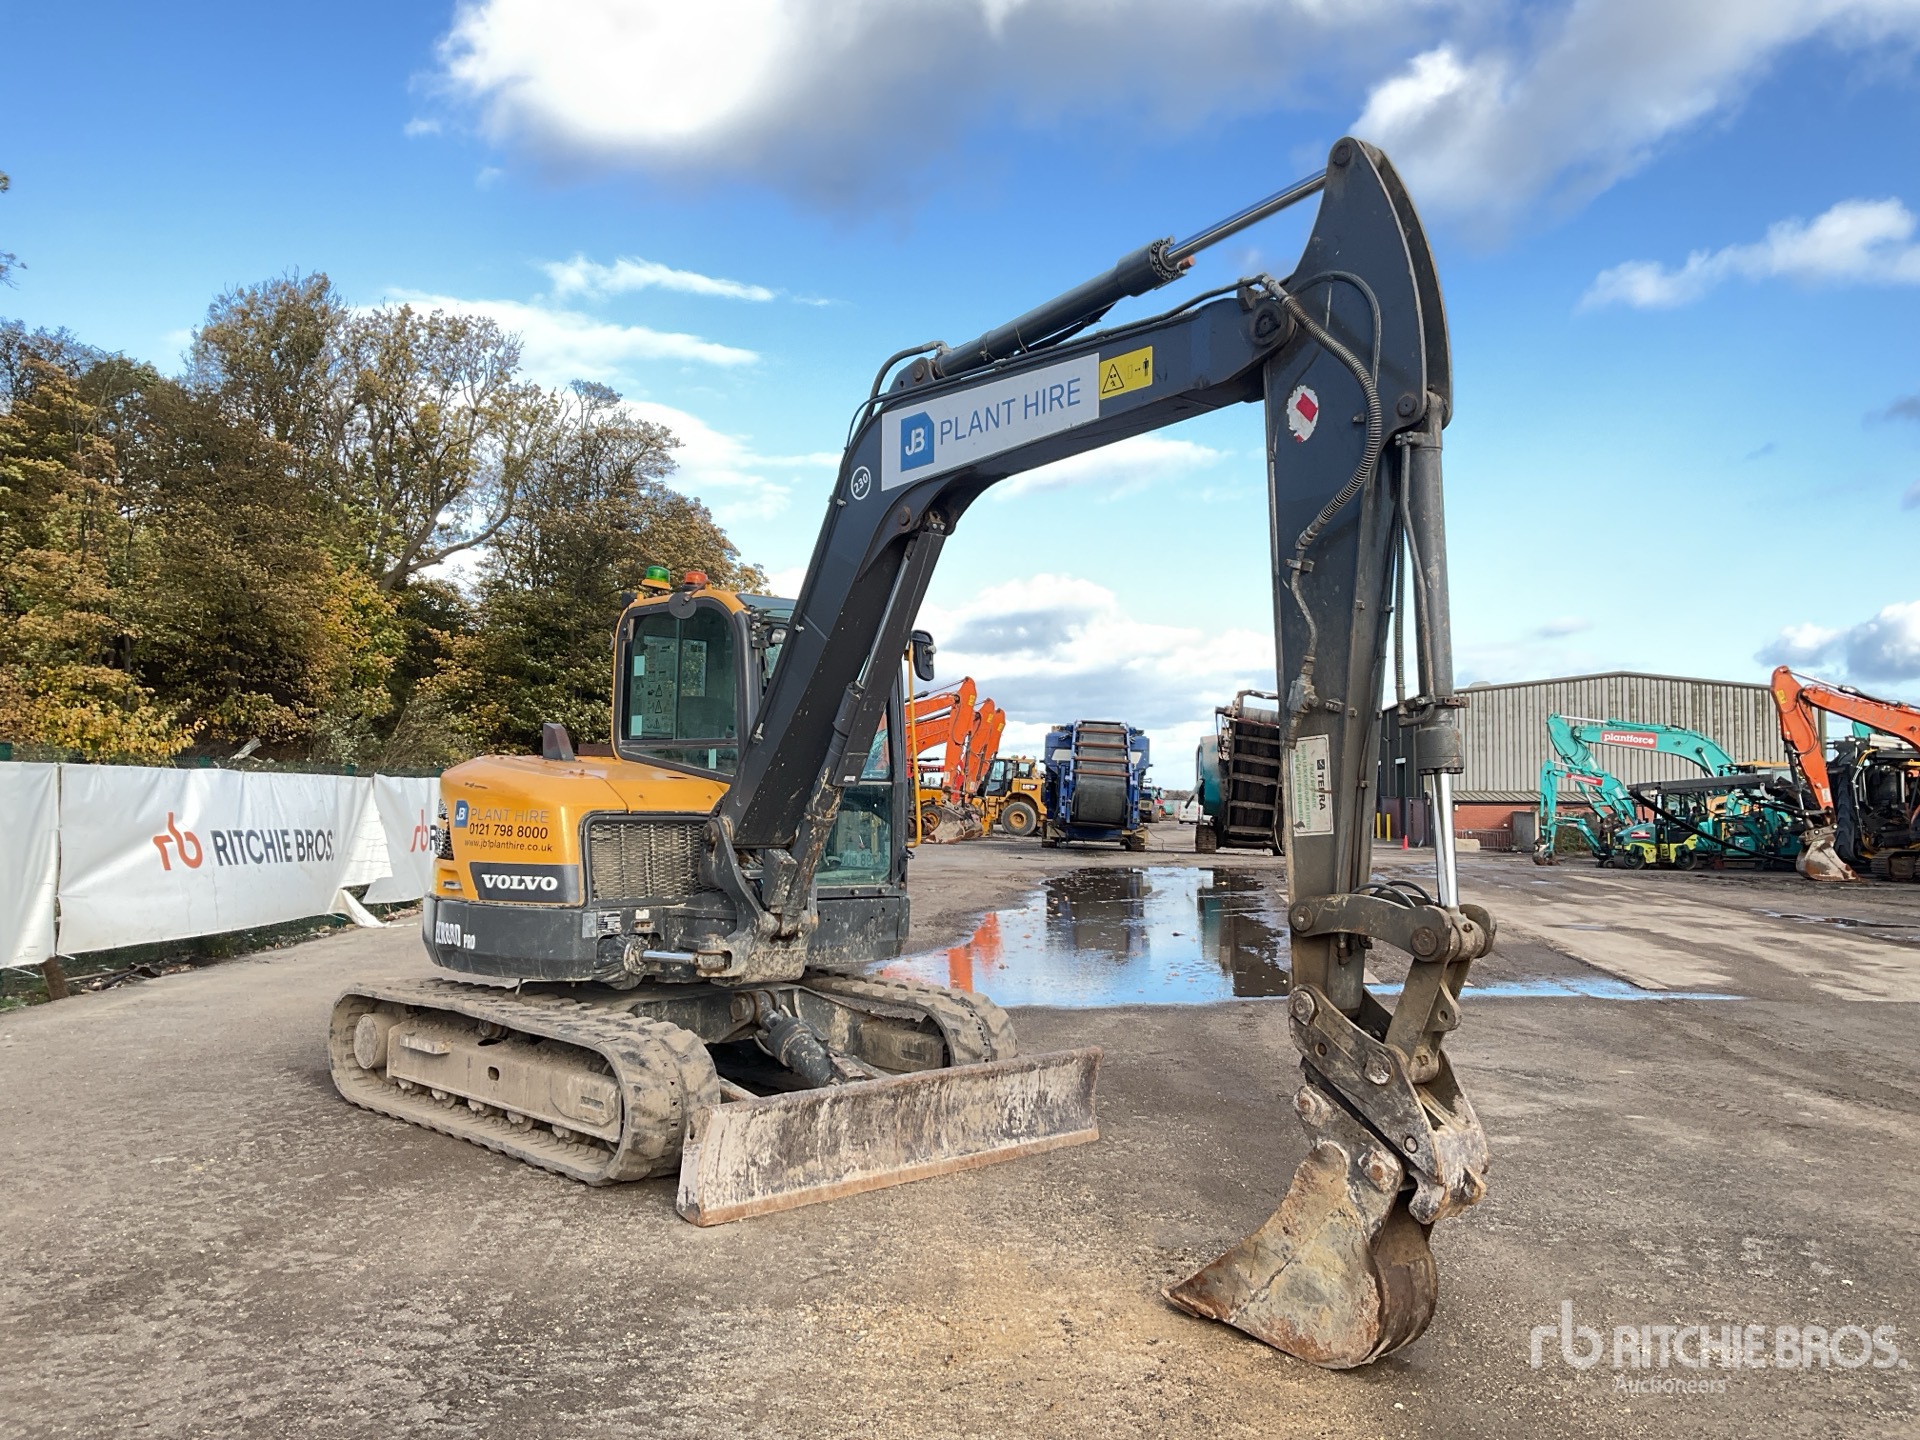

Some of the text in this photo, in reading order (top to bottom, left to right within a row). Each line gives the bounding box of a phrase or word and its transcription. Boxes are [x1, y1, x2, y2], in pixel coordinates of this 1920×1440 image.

[940, 397, 1016, 446] PLANT
[1024, 377, 1081, 420] HIRE
[853, 473, 868, 494] 230
[1603, 732, 1655, 745] plantforce
[470, 808, 508, 822] PLANT
[515, 810, 550, 824] HIRE
[469, 822, 548, 840] 0121 798 8000
[210, 829, 293, 866] RITCHIE
[464, 838, 553, 853] www.jb1planthire.co.uk
[481, 873, 558, 891] VOLVO
[463, 933, 475, 950] PRO
